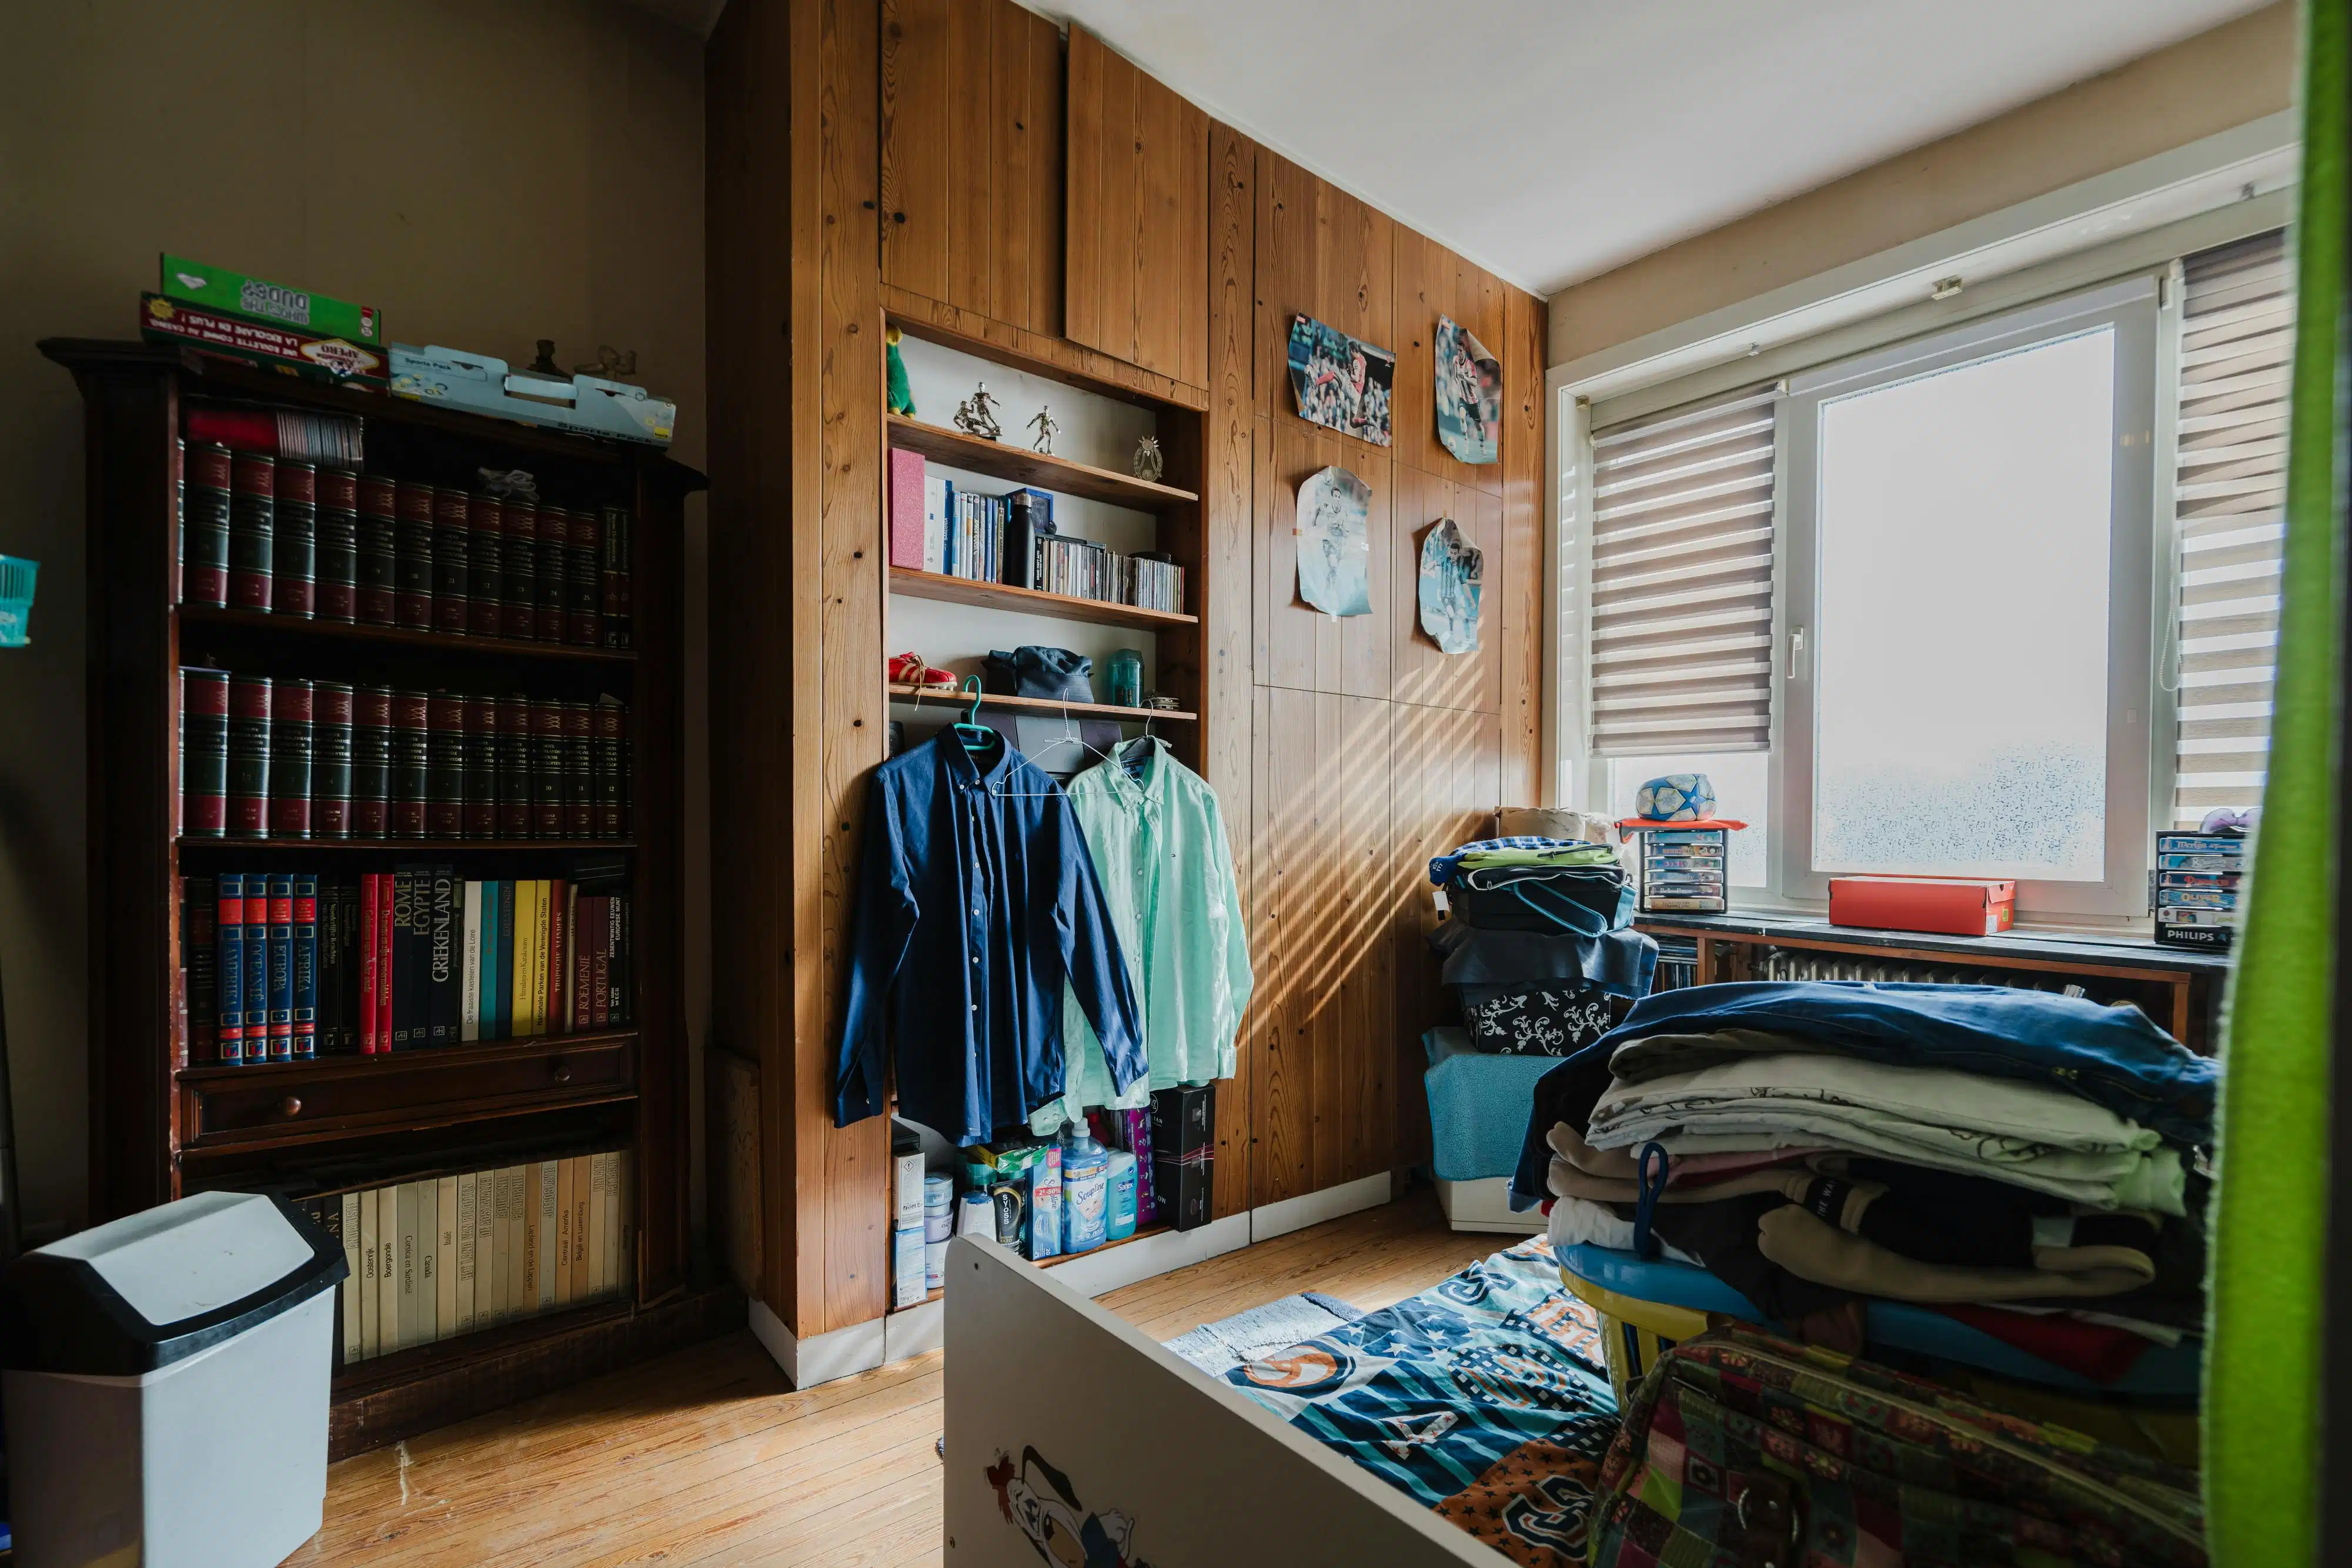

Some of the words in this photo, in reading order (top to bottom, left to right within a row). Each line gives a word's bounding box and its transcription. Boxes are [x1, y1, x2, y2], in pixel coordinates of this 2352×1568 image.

[242, 279, 308, 310] DUDE?
[405, 357, 428, 369] Sports
[431, 361, 452, 372] Pack
[557, 422, 610, 437] Sports
[616, 432, 653, 445] Pack
[395, 880, 412, 927] ROME
[413, 879, 430, 936] EGYPTE
[432, 878, 451, 982] GRIEKENLAND
[539, 920, 548, 950] Verenigde
[2167, 930, 2214, 941] PHILIPS
[469, 945, 476, 954] de
[539, 951, 546, 959] de
[273, 944, 286, 992] EUROPA
[298, 943, 310, 993] AFRIKA
[467, 966, 475, 991] kastelen
[554, 951, 562, 992] TROPISCHE
[595, 949, 607, 1008] PORTUGAL
[578, 954, 592, 1010] ROEMENIË
[467, 992, 475, 1014] fraaiste
[536, 995, 544, 1026] Nationale
[466, 1015, 473, 1024] De
[593, 1159, 604, 1192] FINLAND
[1118, 1182, 1134, 1191] Sanex
[462, 1183, 475, 1222] BELOFTEN
[1077, 1182, 1104, 1205] Soupline
[577, 1201, 585, 1234] Luxemburg
[1818, 1199, 1828, 1216] THE
[461, 1223, 474, 1240] VAN
[479, 1226, 492, 1238] DE
[527, 1225, 536, 1249] Lapland
[577, 1235, 583, 1243] en
[404, 1235, 413, 1259] Corsica
[461, 1242, 473, 1263] LAND
[561, 1240, 569, 1266] Centraal
[576, 1243, 584, 1261] België
[383, 1242, 392, 1278] Boergondië
[406, 1259, 412, 1268] en
[424, 1255, 433, 1278] Canada
[461, 1266, 473, 1281] HET
